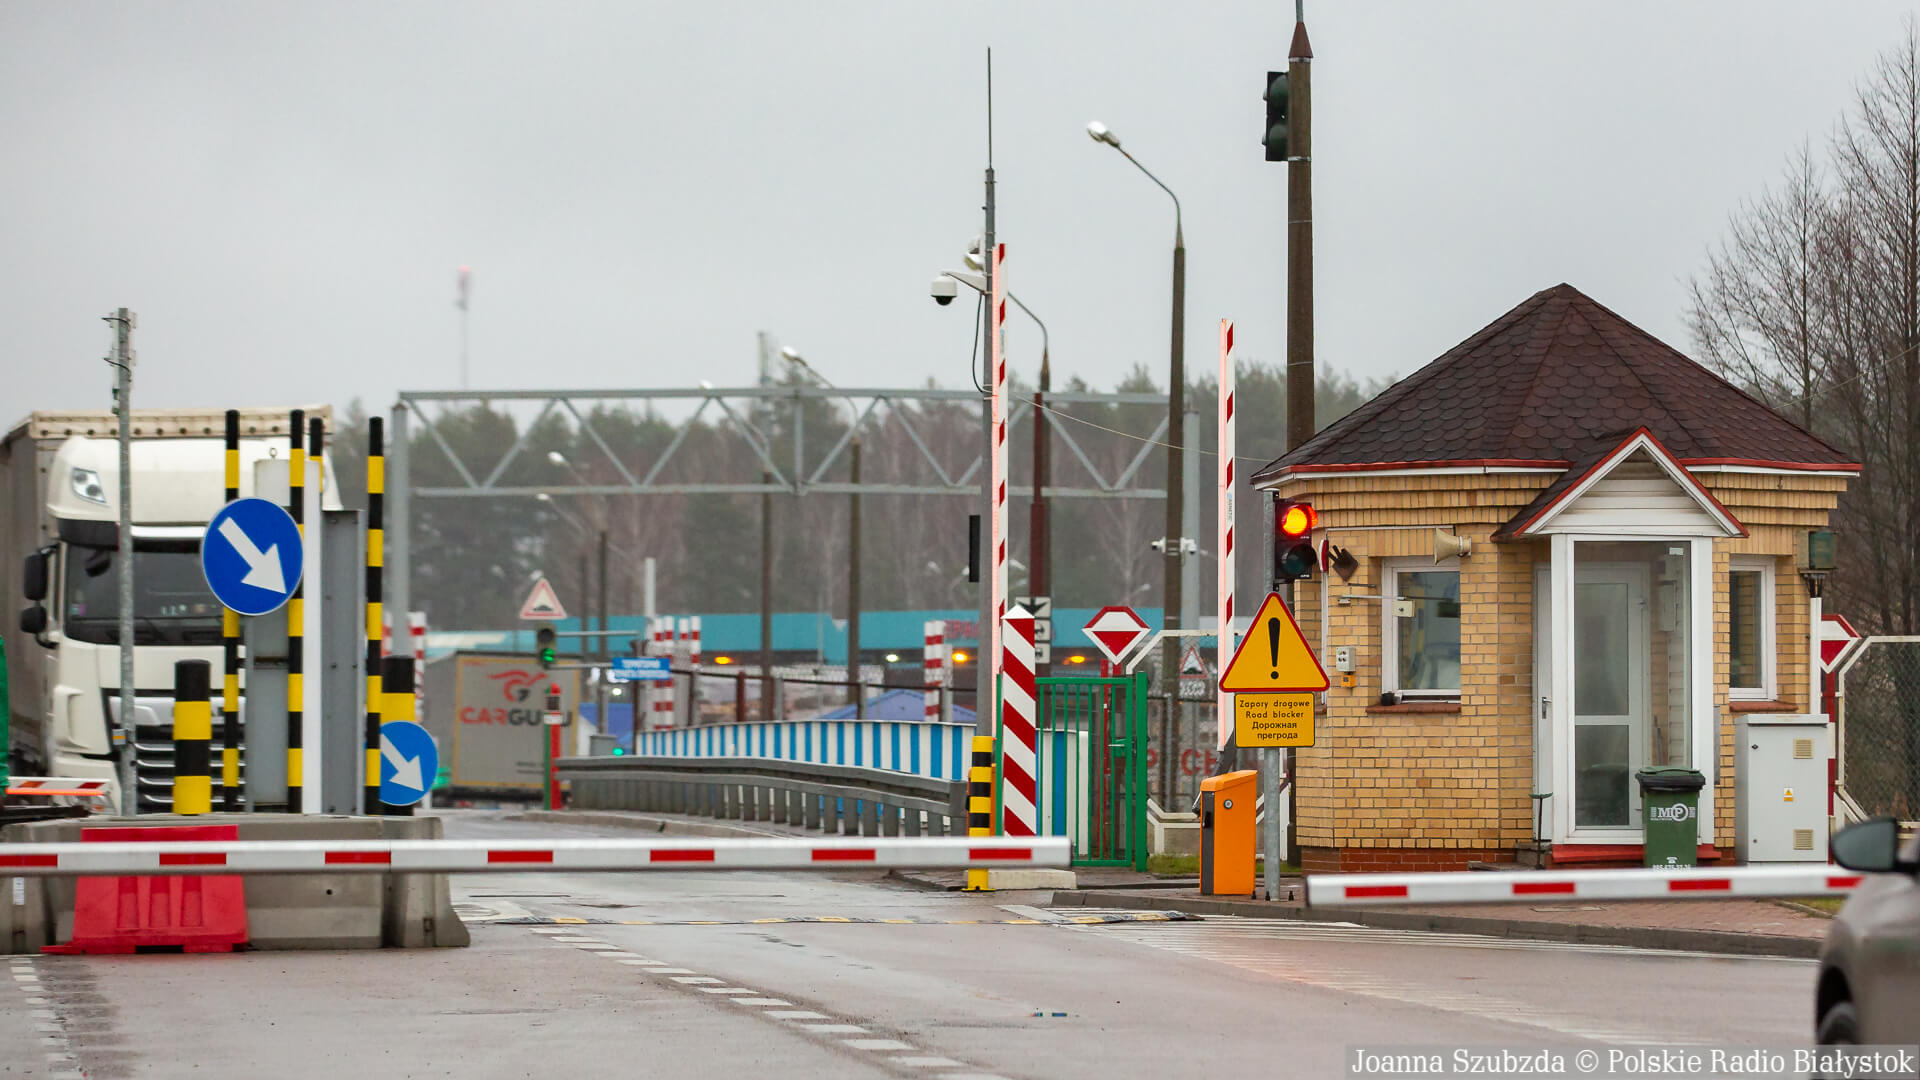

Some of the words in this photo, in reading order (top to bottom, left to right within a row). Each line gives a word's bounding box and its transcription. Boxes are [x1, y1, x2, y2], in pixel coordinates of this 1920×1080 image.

[1240, 700, 1269, 709] Zapory
[1274, 700, 1310, 709] drogowe
[1252, 721, 1297, 730] Дорожная
